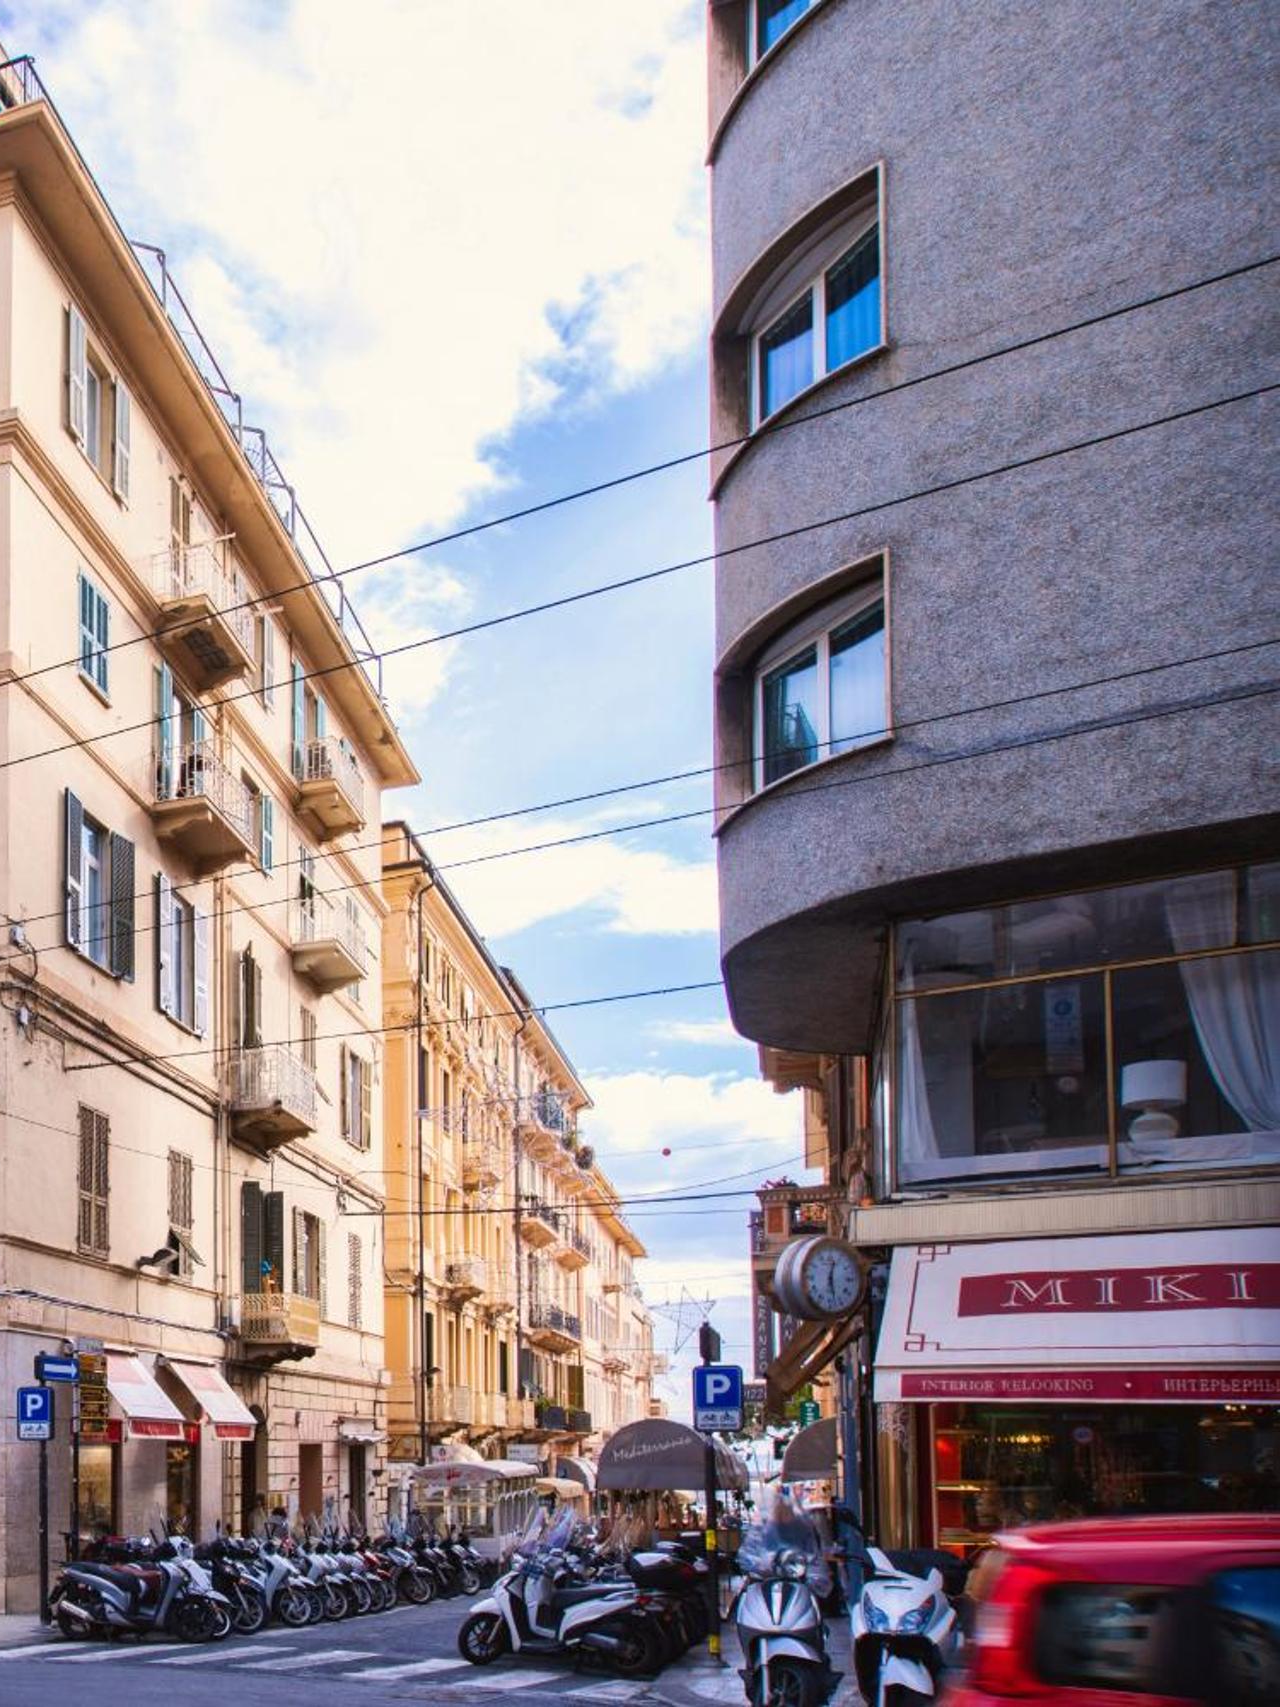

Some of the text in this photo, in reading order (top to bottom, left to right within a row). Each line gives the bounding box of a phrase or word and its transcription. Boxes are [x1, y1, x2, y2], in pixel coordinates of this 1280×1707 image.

[1000, 1272, 1257, 1307] MIKI
[706, 1374, 731, 1404] P
[921, 1379, 1094, 1392] INTERIOR RELOOKING
[26, 1394, 43, 1418] P
